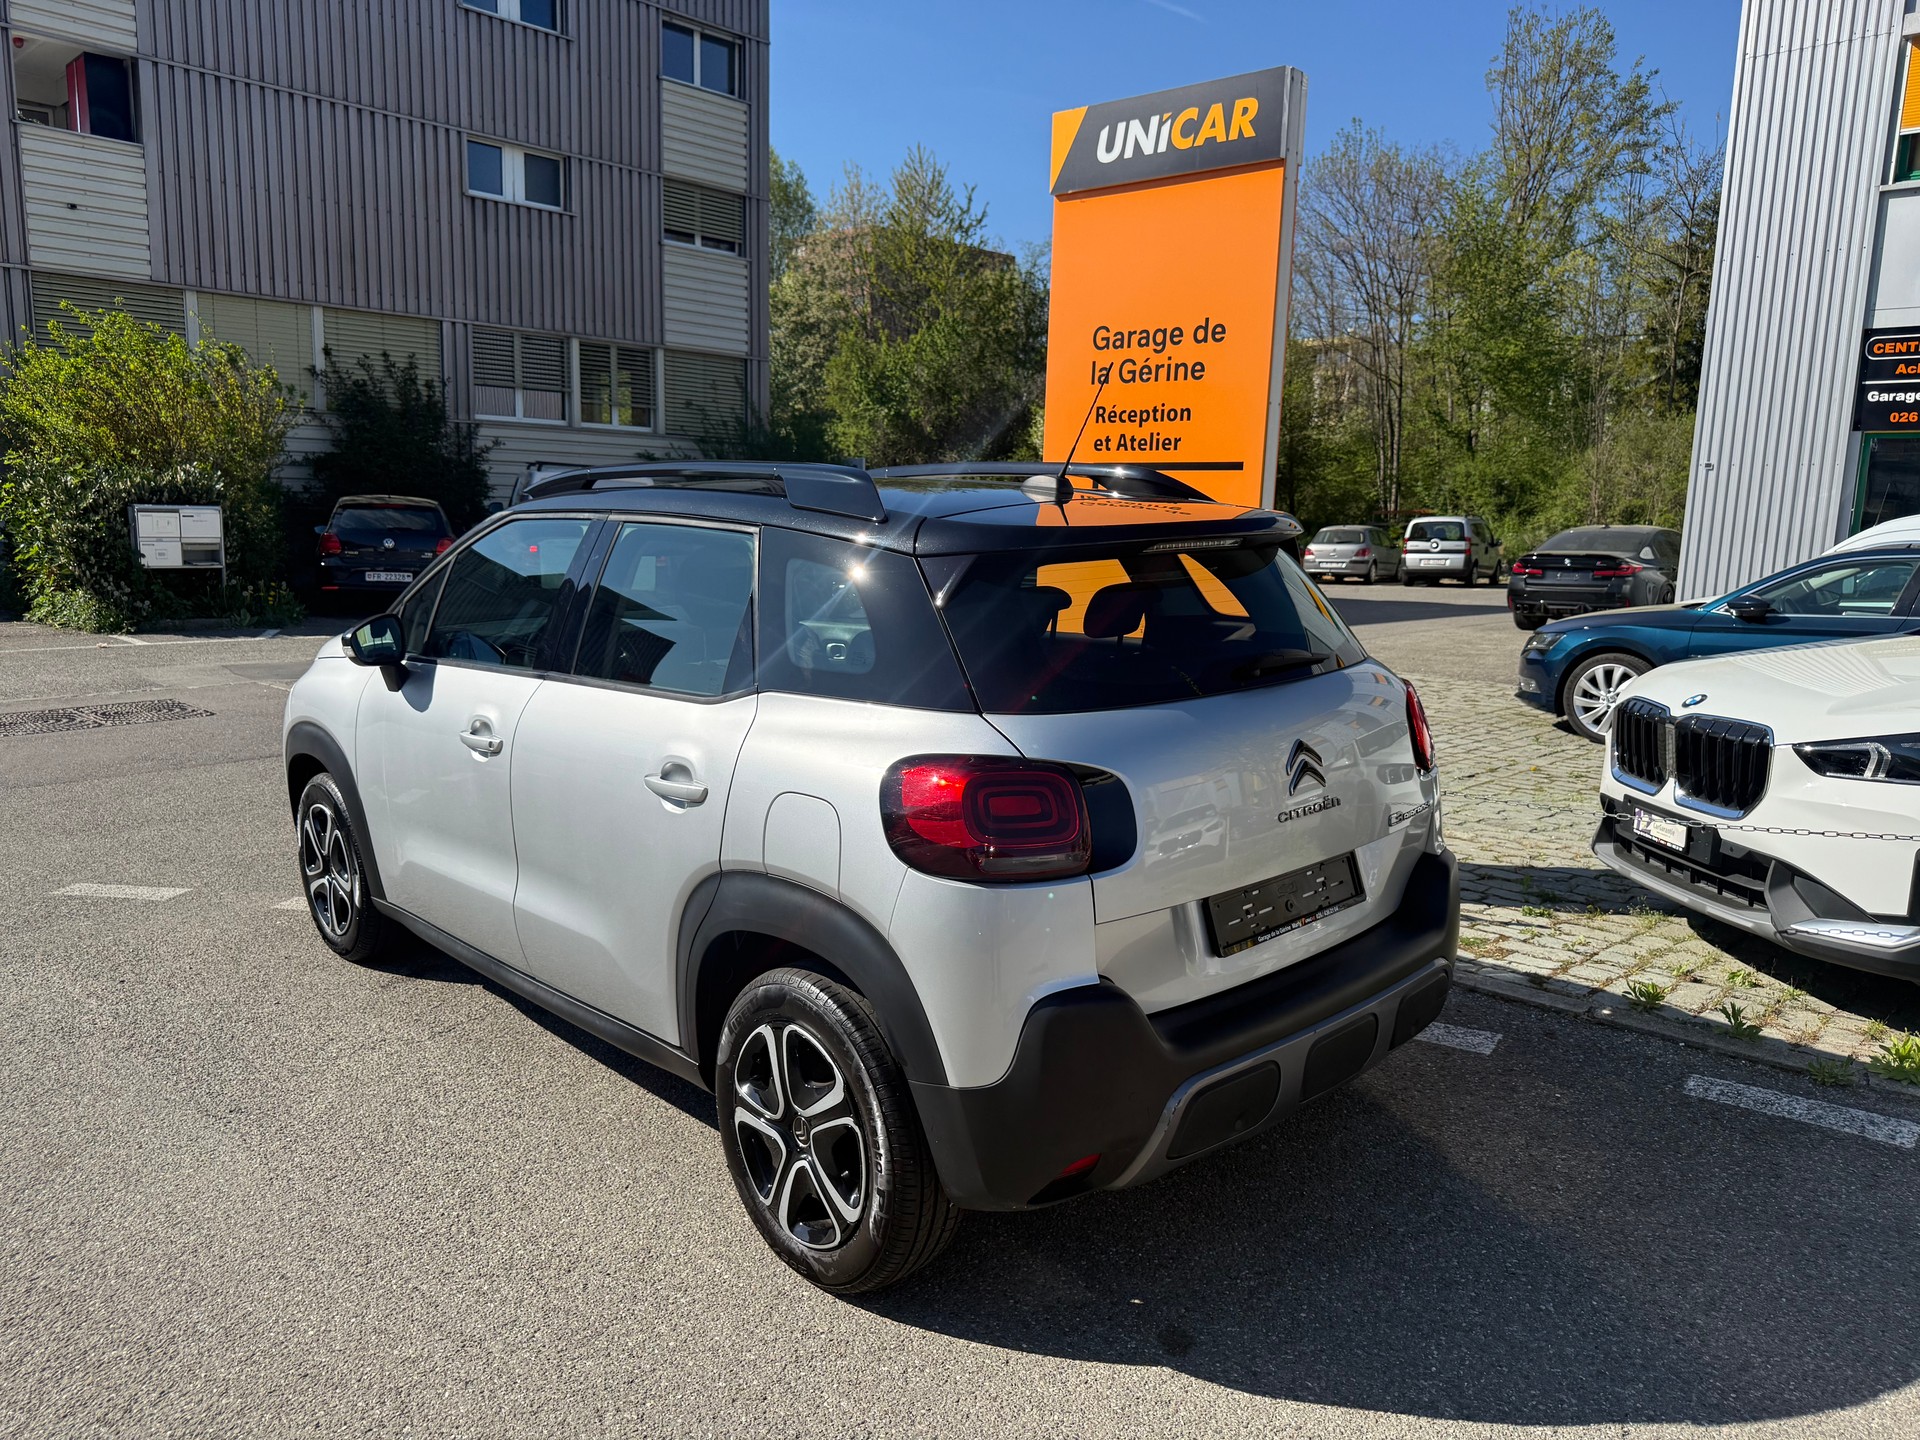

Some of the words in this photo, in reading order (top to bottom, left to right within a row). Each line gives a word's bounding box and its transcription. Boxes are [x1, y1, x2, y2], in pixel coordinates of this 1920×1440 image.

[1093, 326, 1183, 354] Garage
[1193, 317, 1226, 344] de
[1873, 342, 1920, 354] CENT
[1091, 361, 1110, 385] la
[1119, 356, 1205, 383] Gérine
[1895, 363, 1920, 375] Ac
[1095, 403, 1191, 427] Réception
[1890, 412, 1919, 423] 026
[1094, 436, 1111, 451] et
[1116, 432, 1181, 451] Atelier
